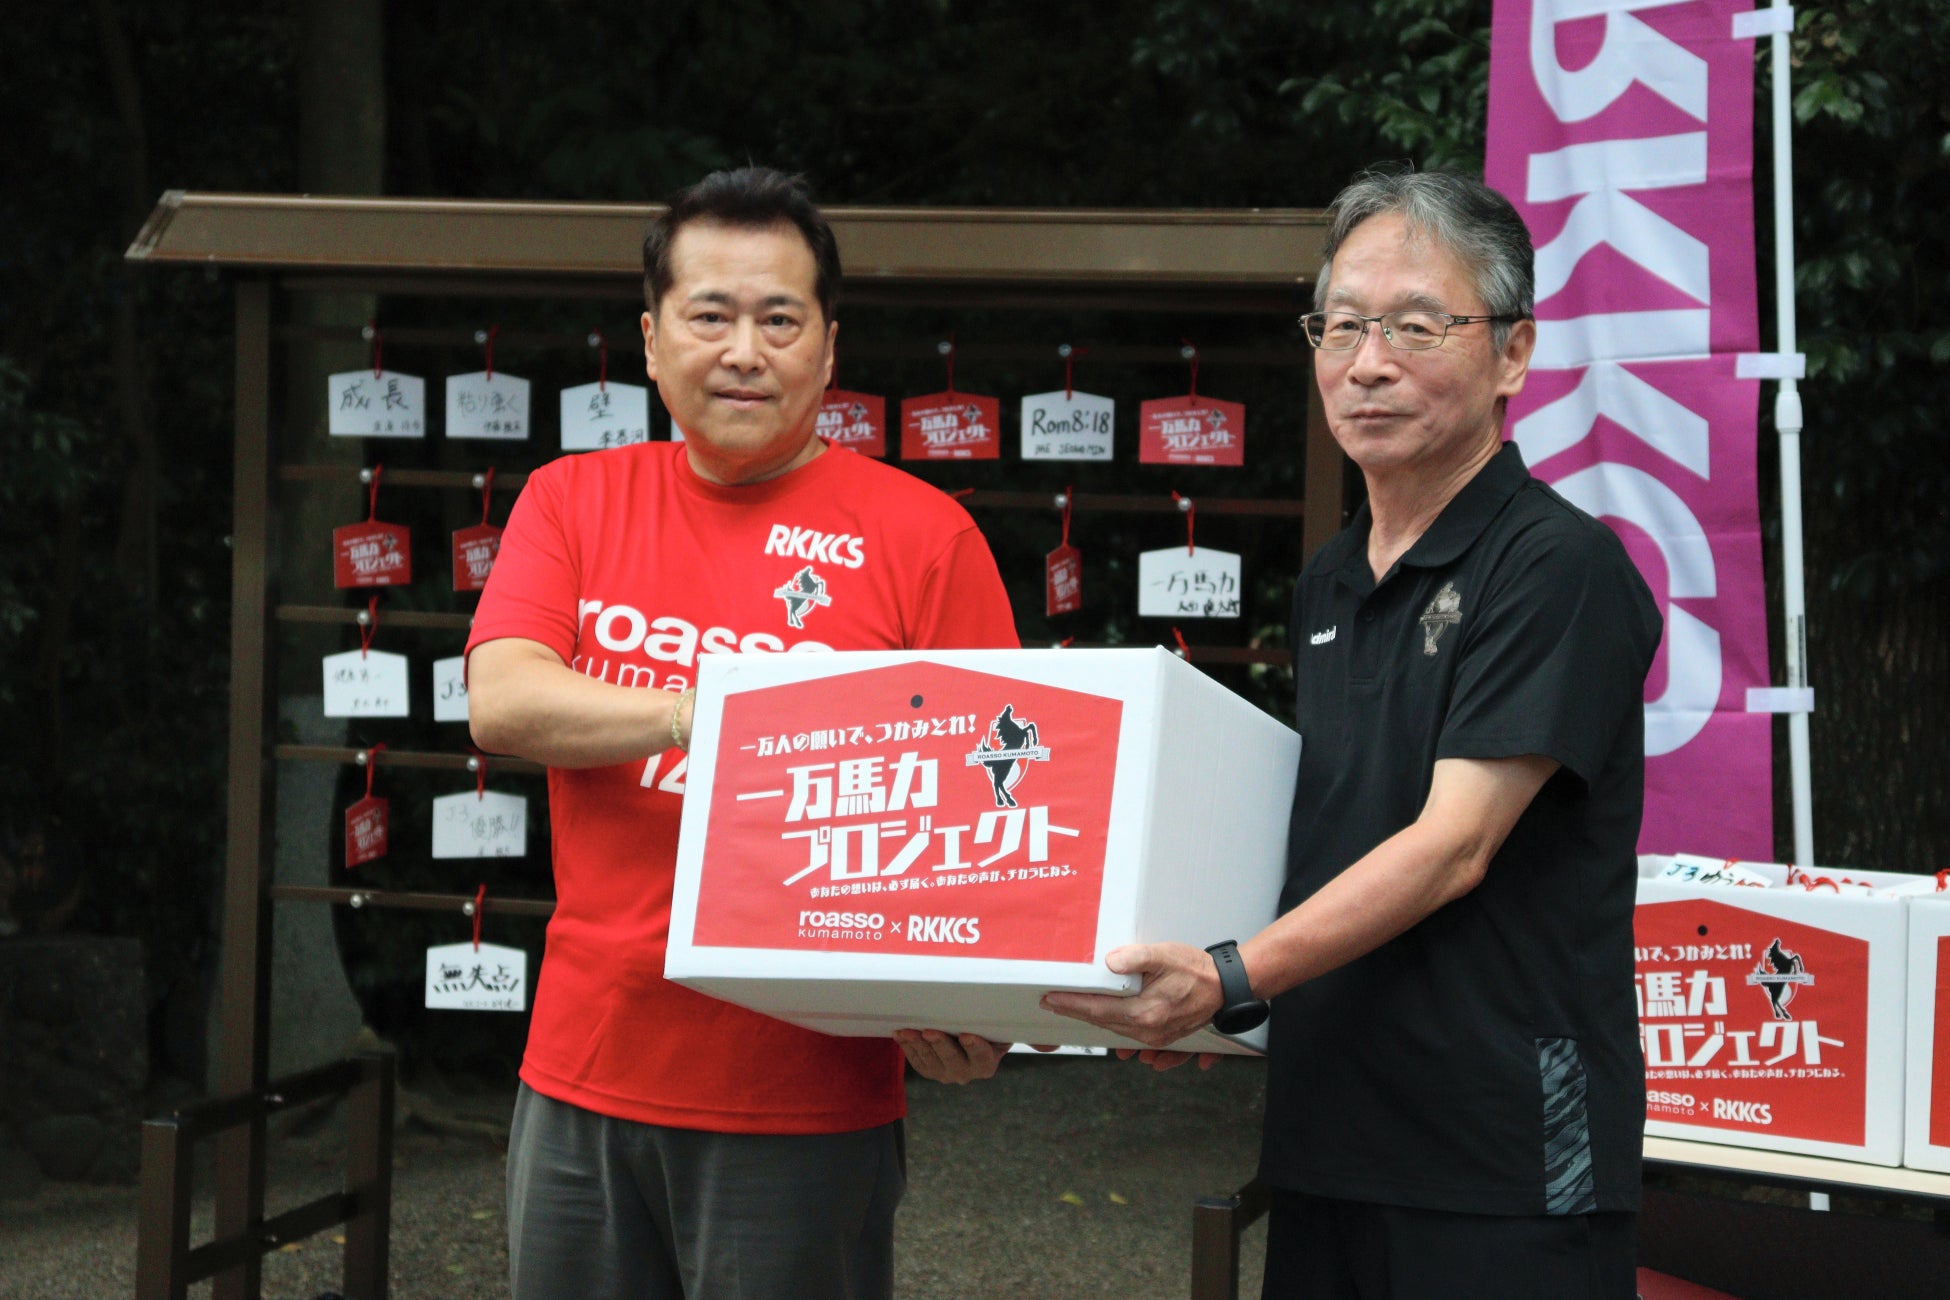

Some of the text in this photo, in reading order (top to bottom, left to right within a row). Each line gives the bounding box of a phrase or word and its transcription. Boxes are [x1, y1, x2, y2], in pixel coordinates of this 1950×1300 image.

[340, 379, 409, 411] 成長
[1031, 408, 1111, 436] Rom8:18
[764, 523, 865, 569] RKKCS
[737, 752, 938, 822] 一万馬力
[781, 806, 1080, 887] プロジェクト
[799, 910, 885, 929] roasso
[907, 915, 981, 944] RKKCS
[799, 929, 883, 941] kumamoto
[1713, 1098, 1773, 1125] RKKCS
